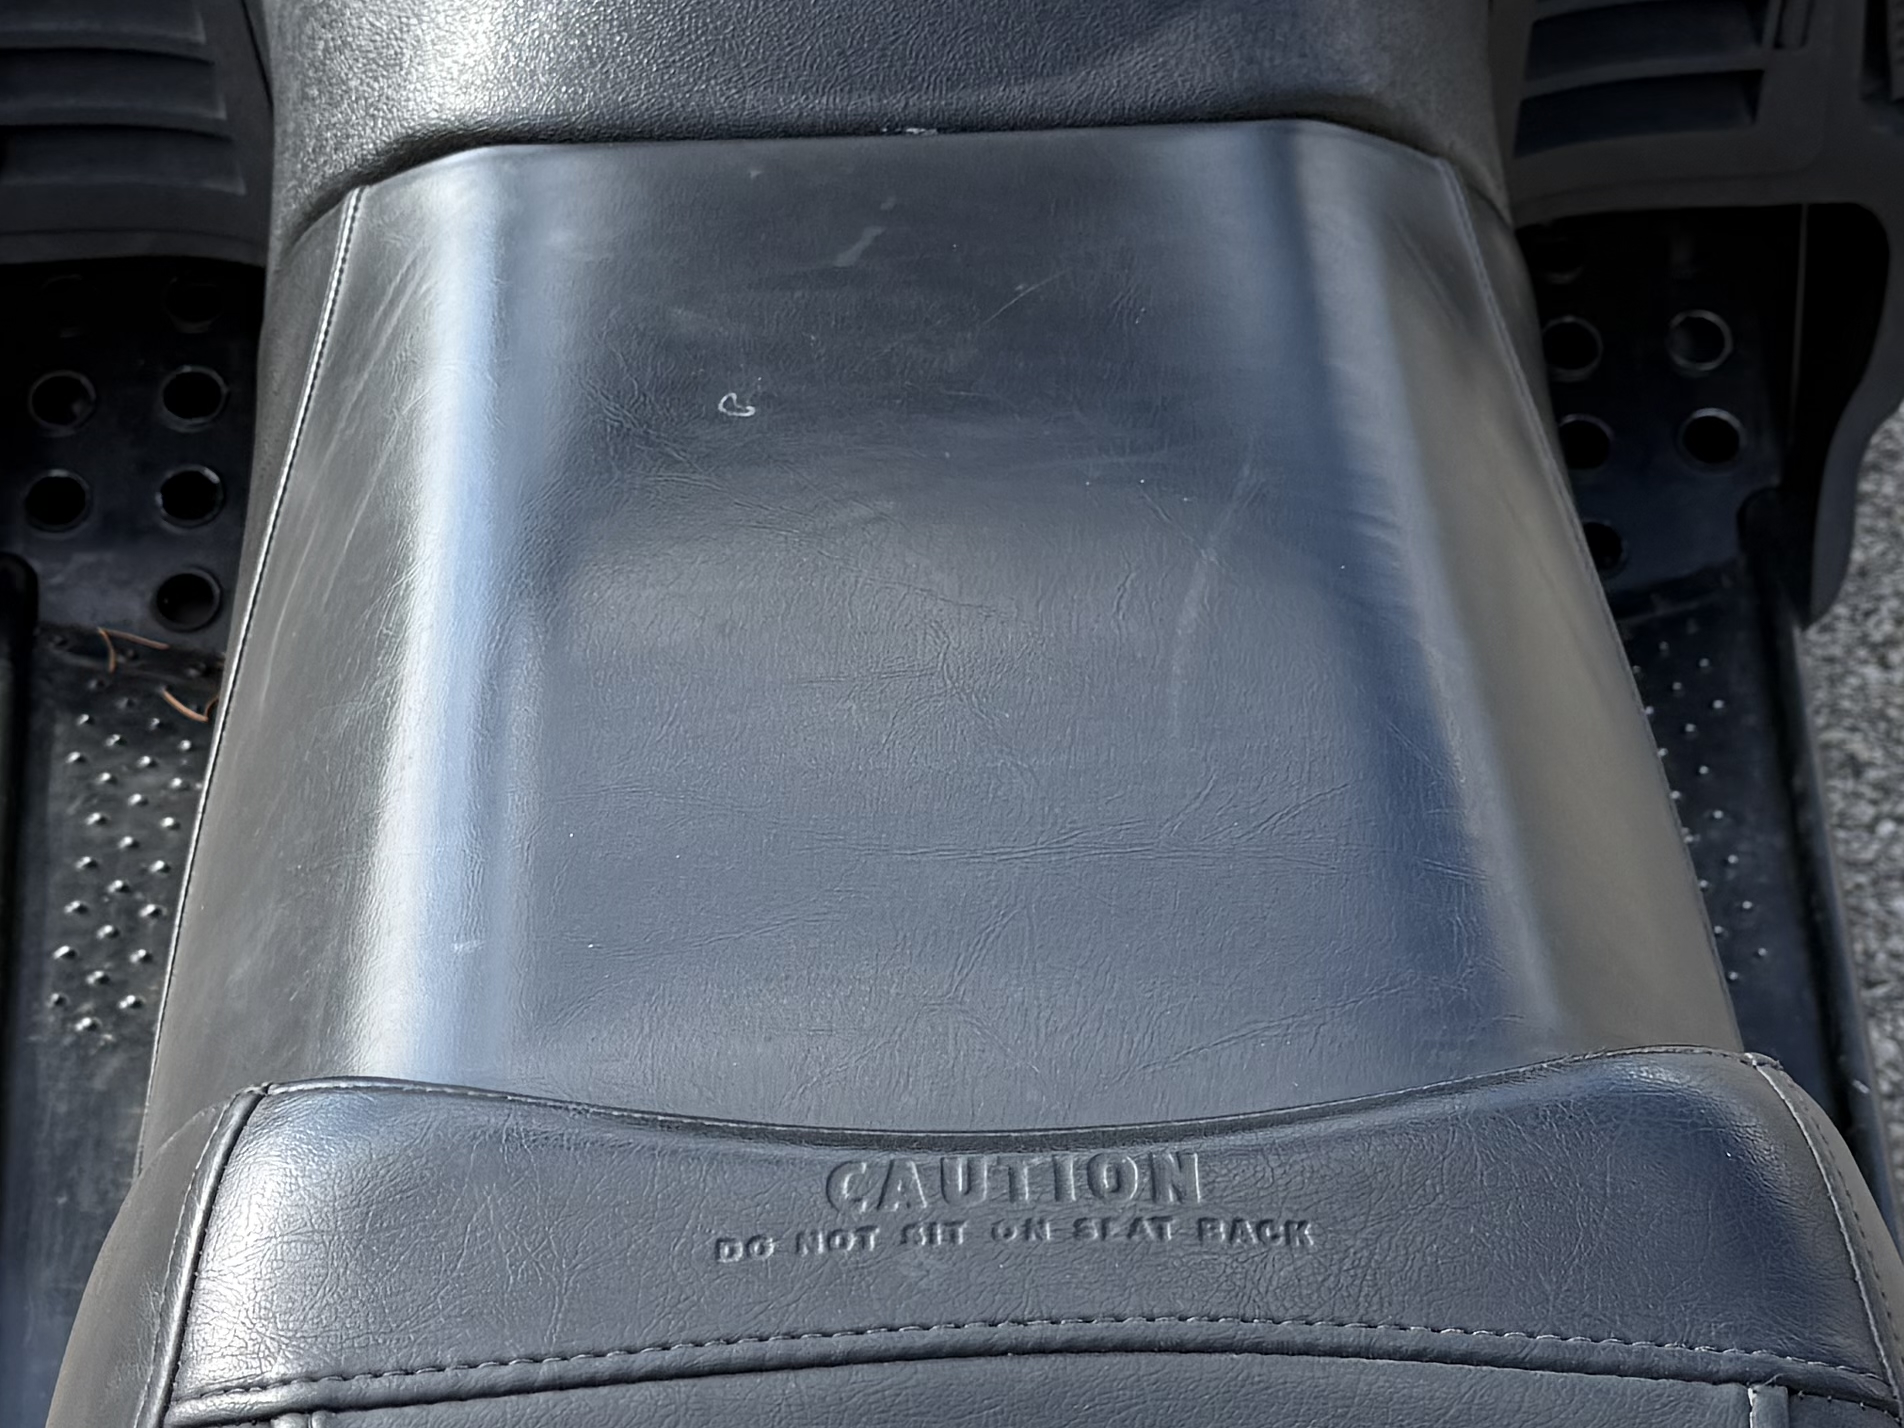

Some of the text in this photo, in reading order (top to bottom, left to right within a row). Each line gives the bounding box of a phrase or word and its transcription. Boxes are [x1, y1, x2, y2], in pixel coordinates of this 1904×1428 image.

[826, 1151, 1203, 1215] CAUTION
[714, 1214, 1318, 1262] DO NOT SIT ON SEAT BACK
